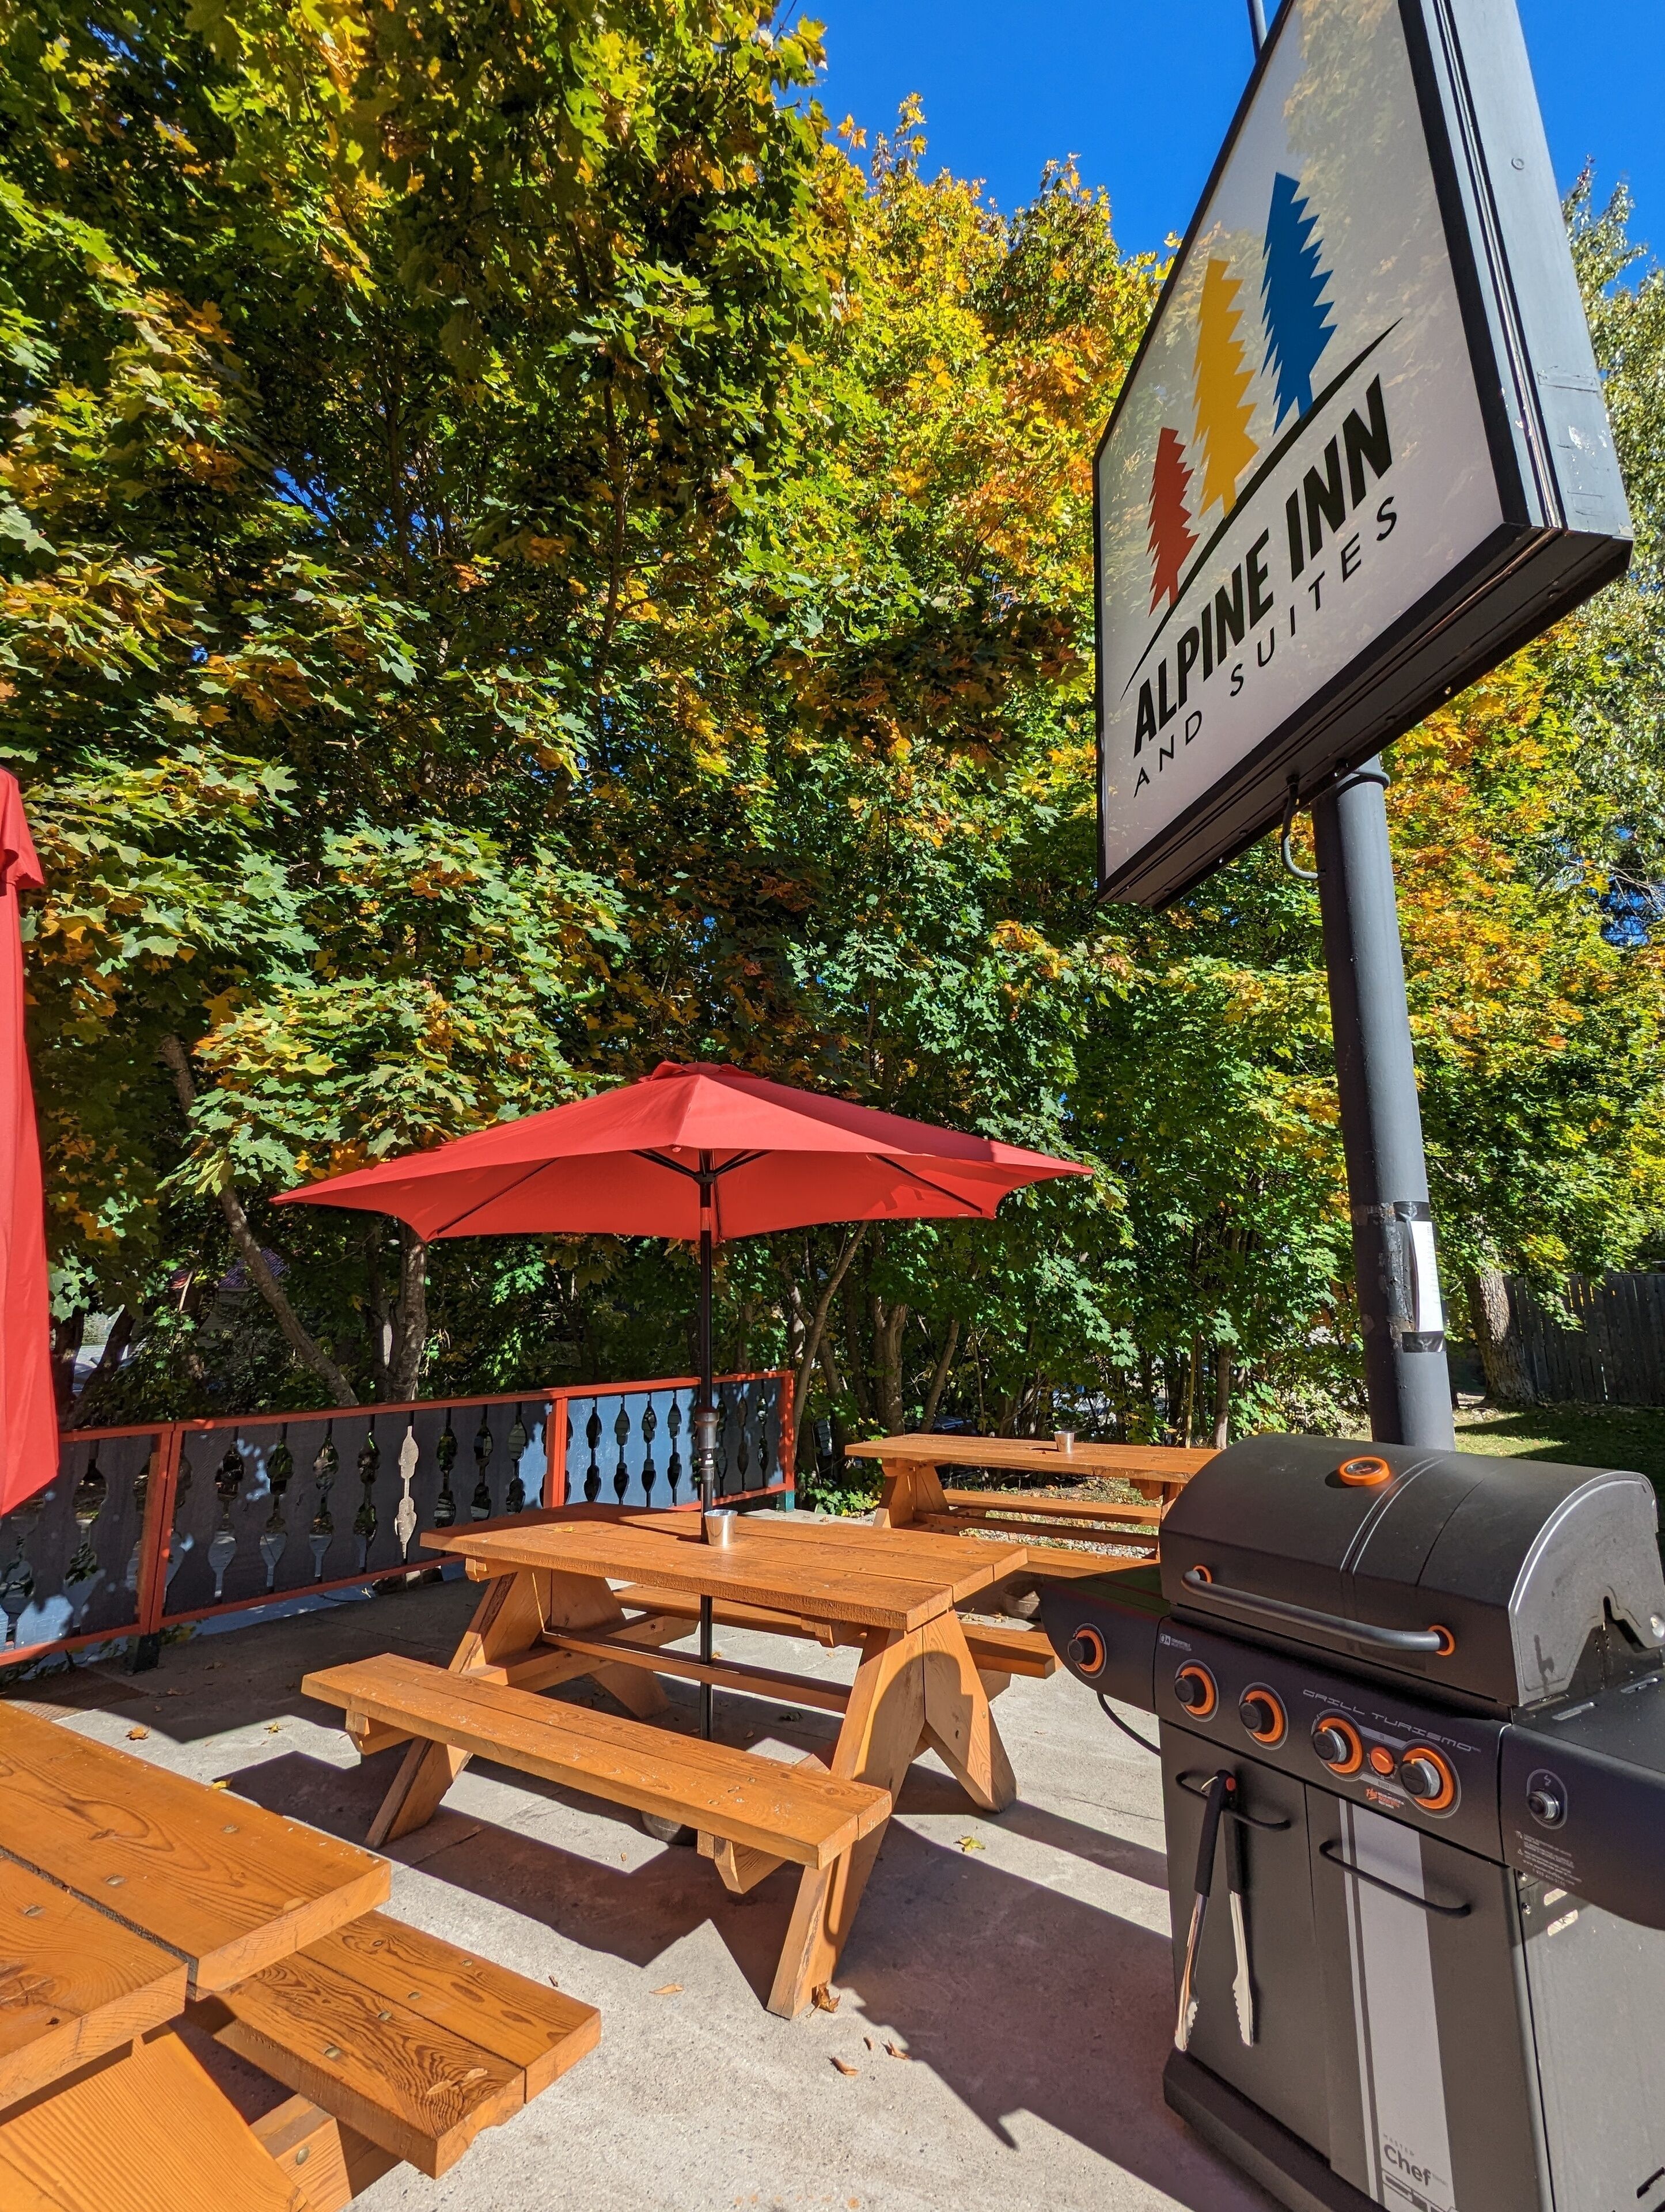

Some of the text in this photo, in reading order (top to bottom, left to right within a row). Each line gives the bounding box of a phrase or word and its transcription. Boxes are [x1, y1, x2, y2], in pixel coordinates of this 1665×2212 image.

[1133, 373, 1392, 759] ALPINE INN
[1133, 496, 1397, 798] AND SUITES
[1303, 1689, 1471, 1752] GRILL TURISMO
[1384, 2144, 1431, 2186] Chef
